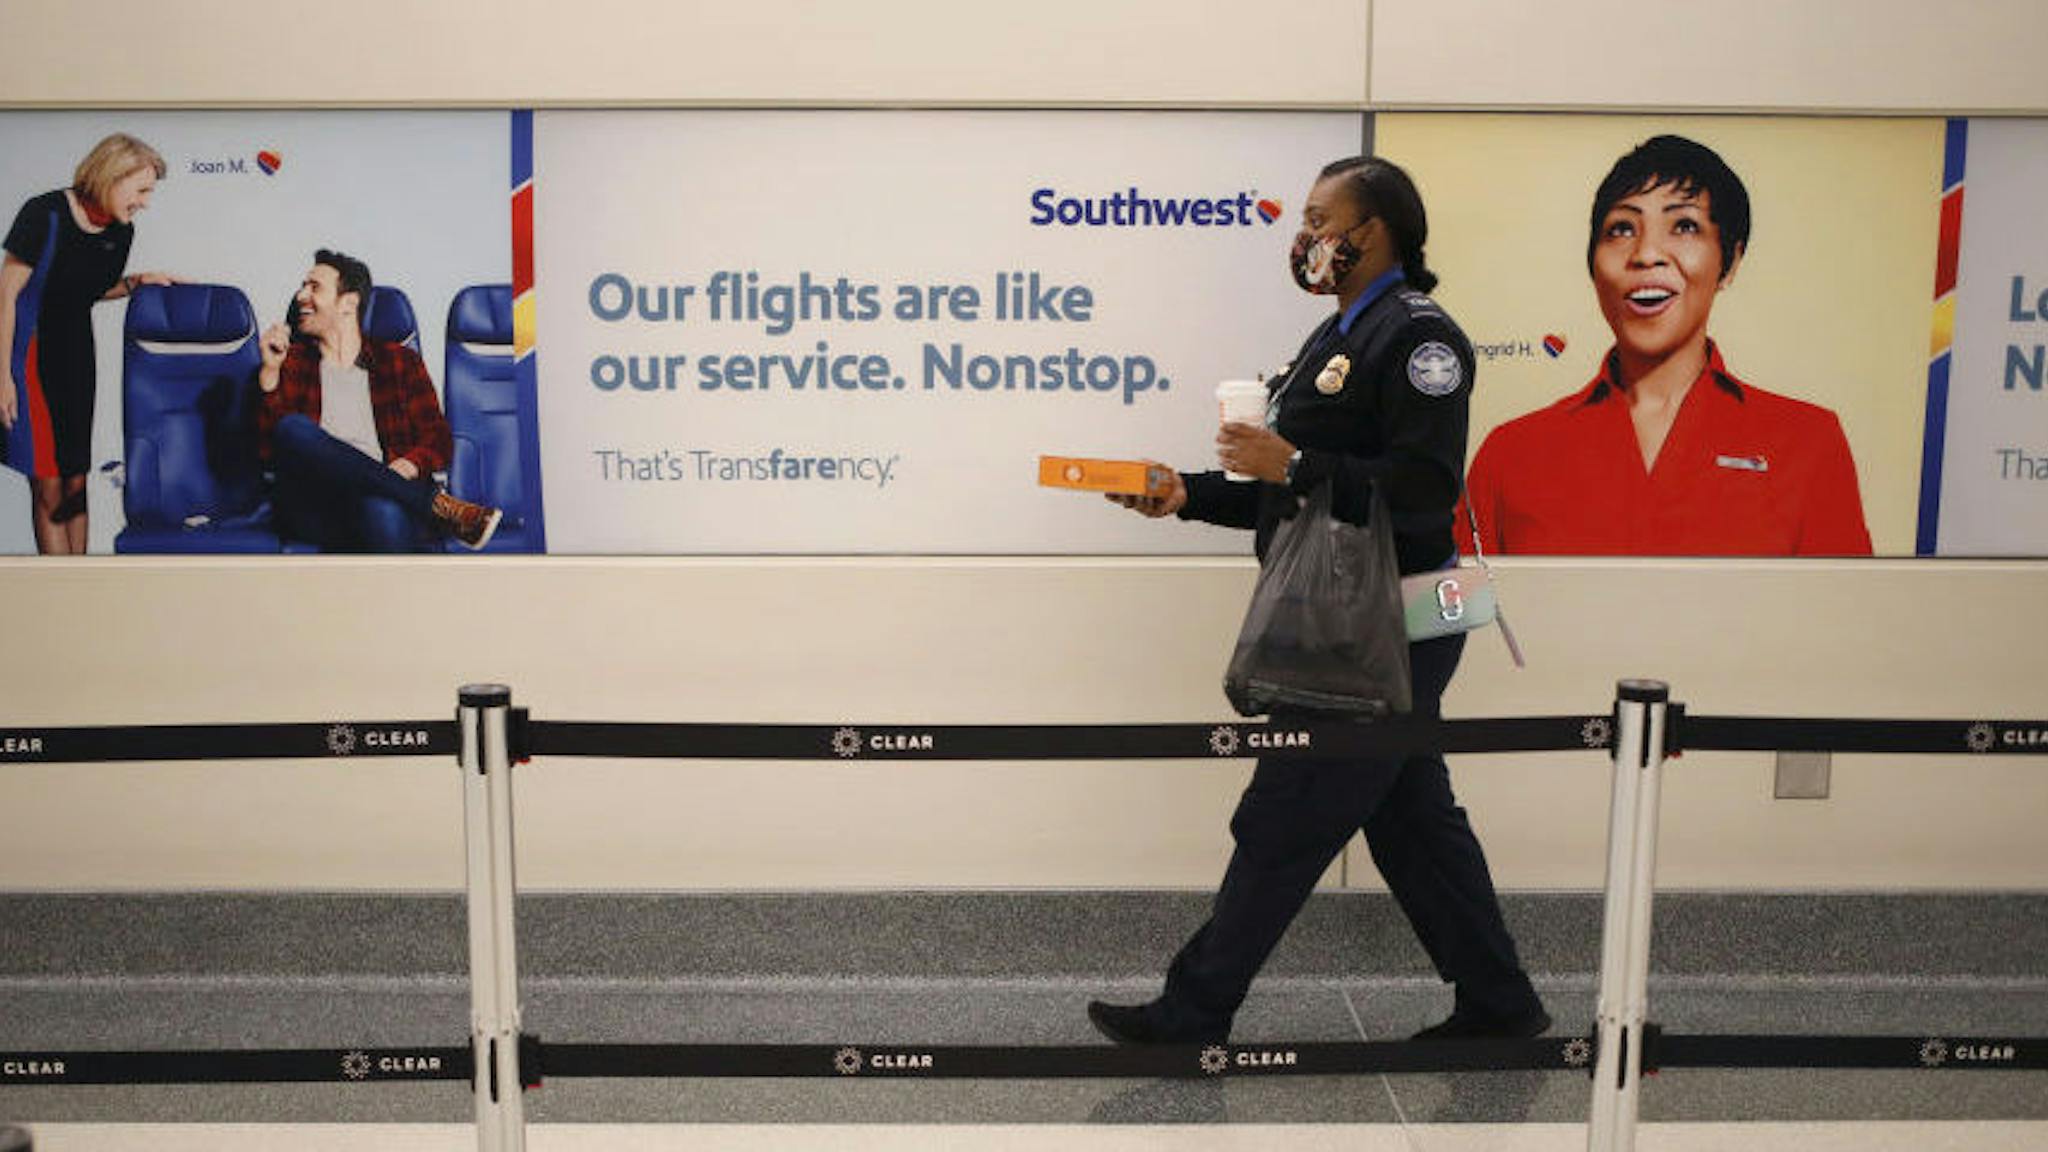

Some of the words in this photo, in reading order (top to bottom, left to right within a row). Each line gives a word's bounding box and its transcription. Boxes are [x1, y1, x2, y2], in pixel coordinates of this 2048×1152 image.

[1030, 187, 1253, 227] Southwest
[588, 273, 694, 322] Our
[706, 271, 881, 336] flights
[893, 285, 981, 322] are
[995, 271, 1093, 323] like
[590, 354, 686, 392] our
[697, 340, 905, 392] service.
[923, 343, 1170, 405] Nonstop.
[593, 448, 683, 481] That's
[689, 447, 895, 488] Transfarency.
[364, 730, 429, 746] CLEAR
[870, 734, 933, 750] CLEAR
[1247, 732, 1310, 748] CLEAR
[1236, 1051, 1297, 1067] CLEAR
[1955, 1045, 2015, 1060] CLEAR
[3, 1061, 65, 1075] CLEAR
[379, 1057, 441, 1072] CLEAR
[871, 1053, 933, 1069] CLEAR
